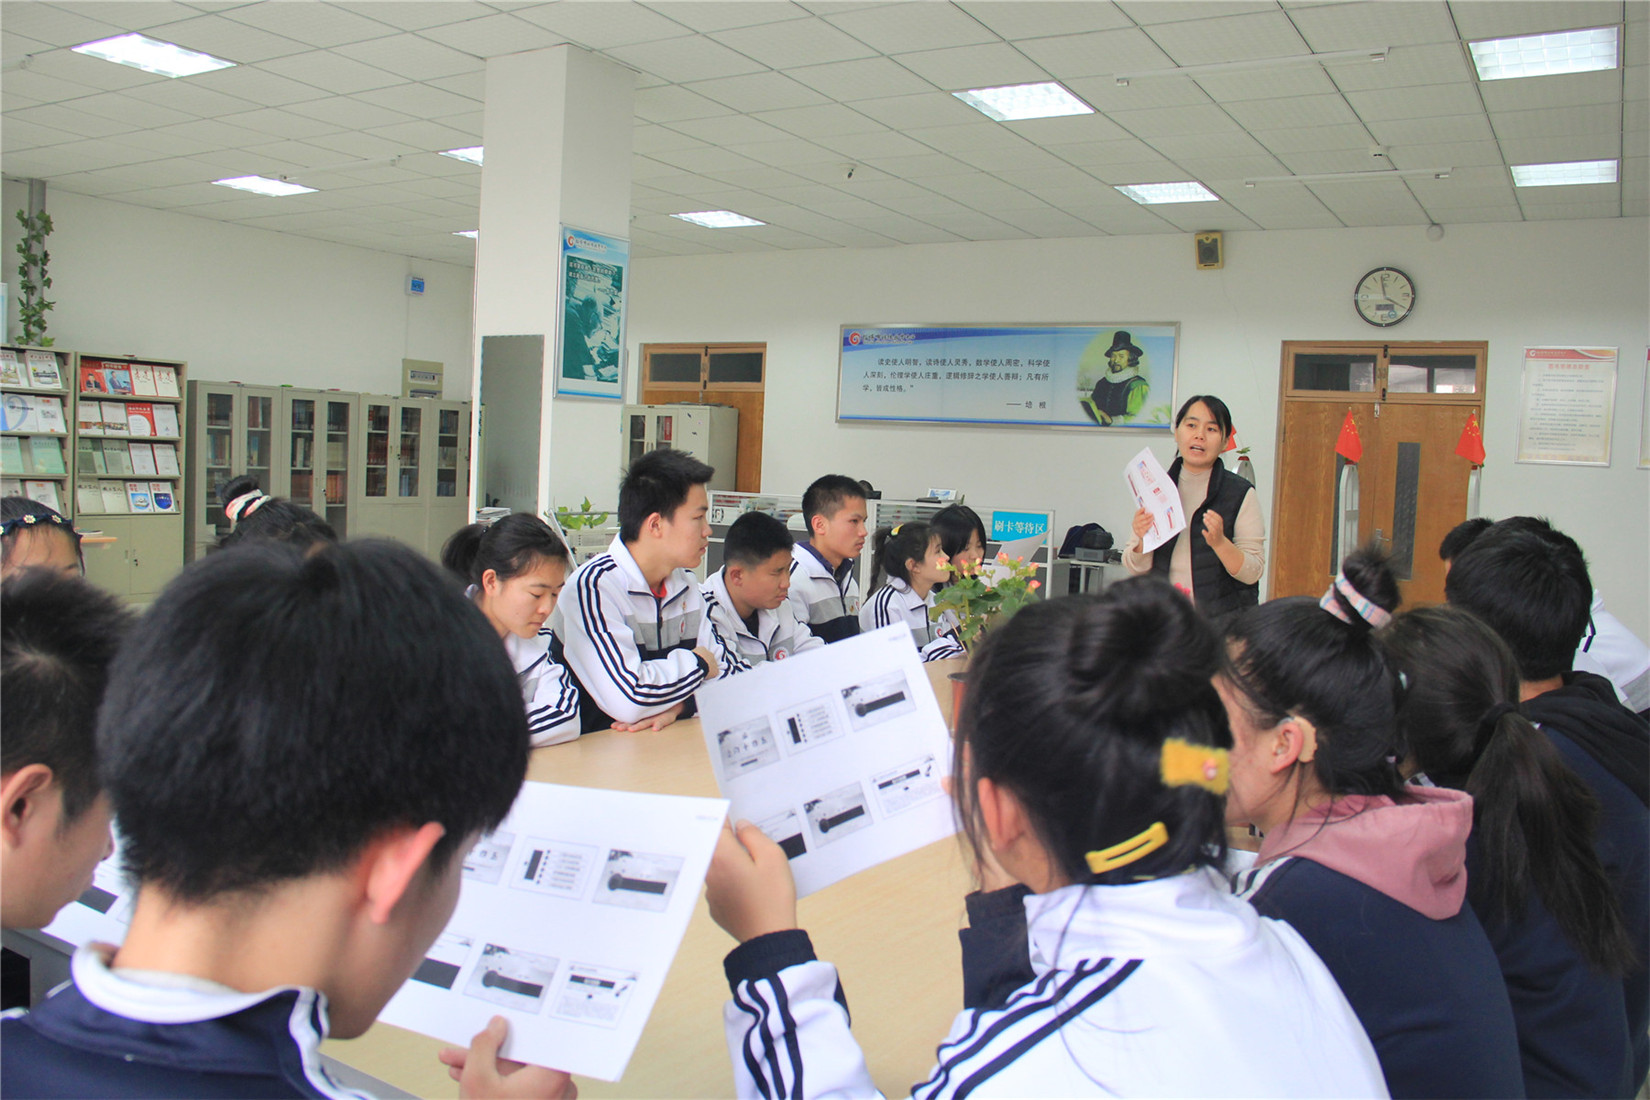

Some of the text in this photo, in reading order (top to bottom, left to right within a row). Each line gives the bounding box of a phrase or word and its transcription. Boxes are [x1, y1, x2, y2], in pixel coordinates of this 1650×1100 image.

[994, 520, 1045, 534] 刷卡等待区
